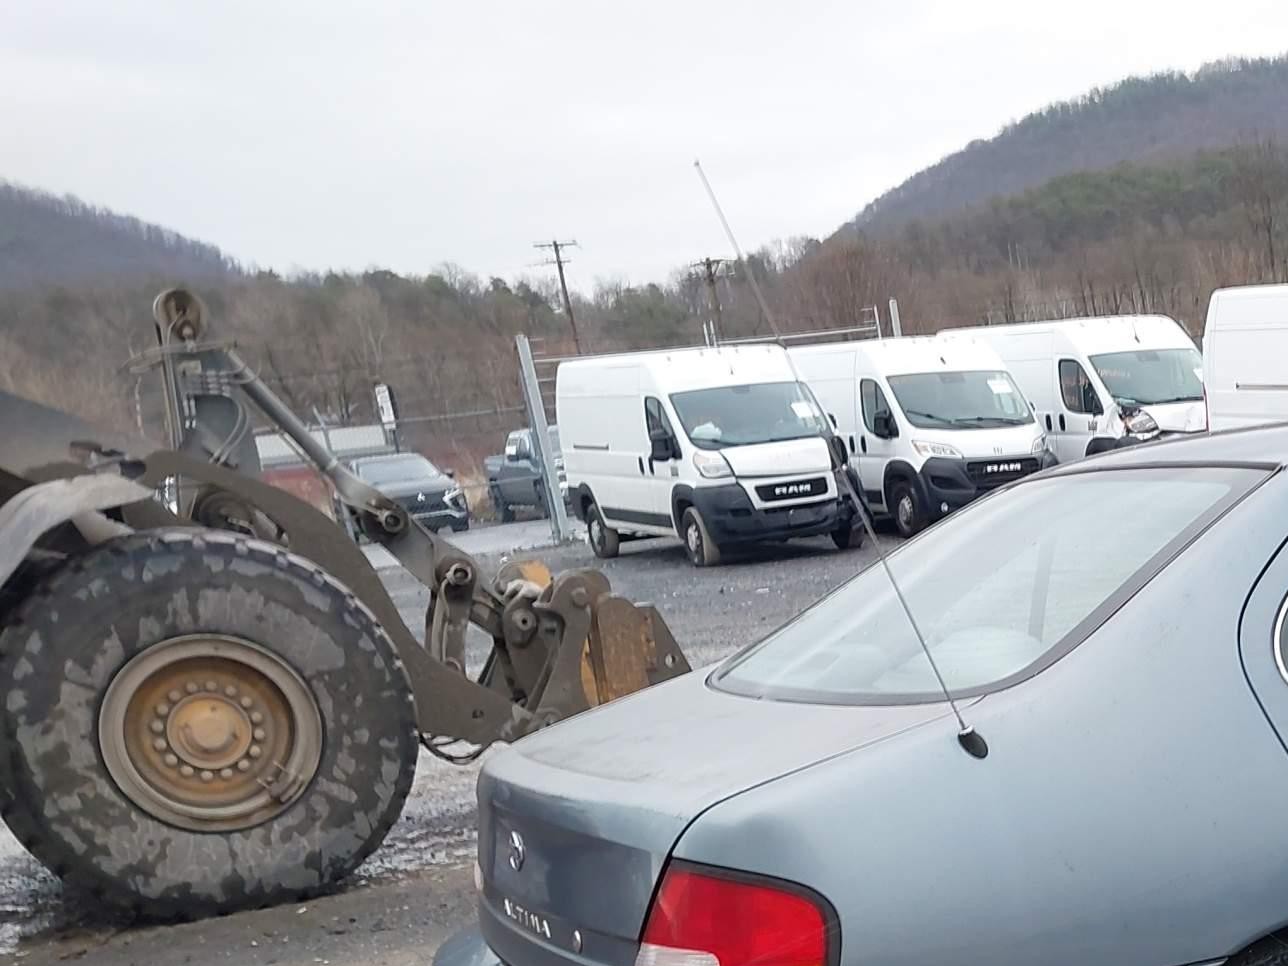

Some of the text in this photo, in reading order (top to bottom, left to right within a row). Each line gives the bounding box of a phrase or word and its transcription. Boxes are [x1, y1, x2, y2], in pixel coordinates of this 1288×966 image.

[986, 463, 1021, 472] RAM
[774, 483, 812, 495] RAM
[504, 898, 551, 938] ALTIMA
